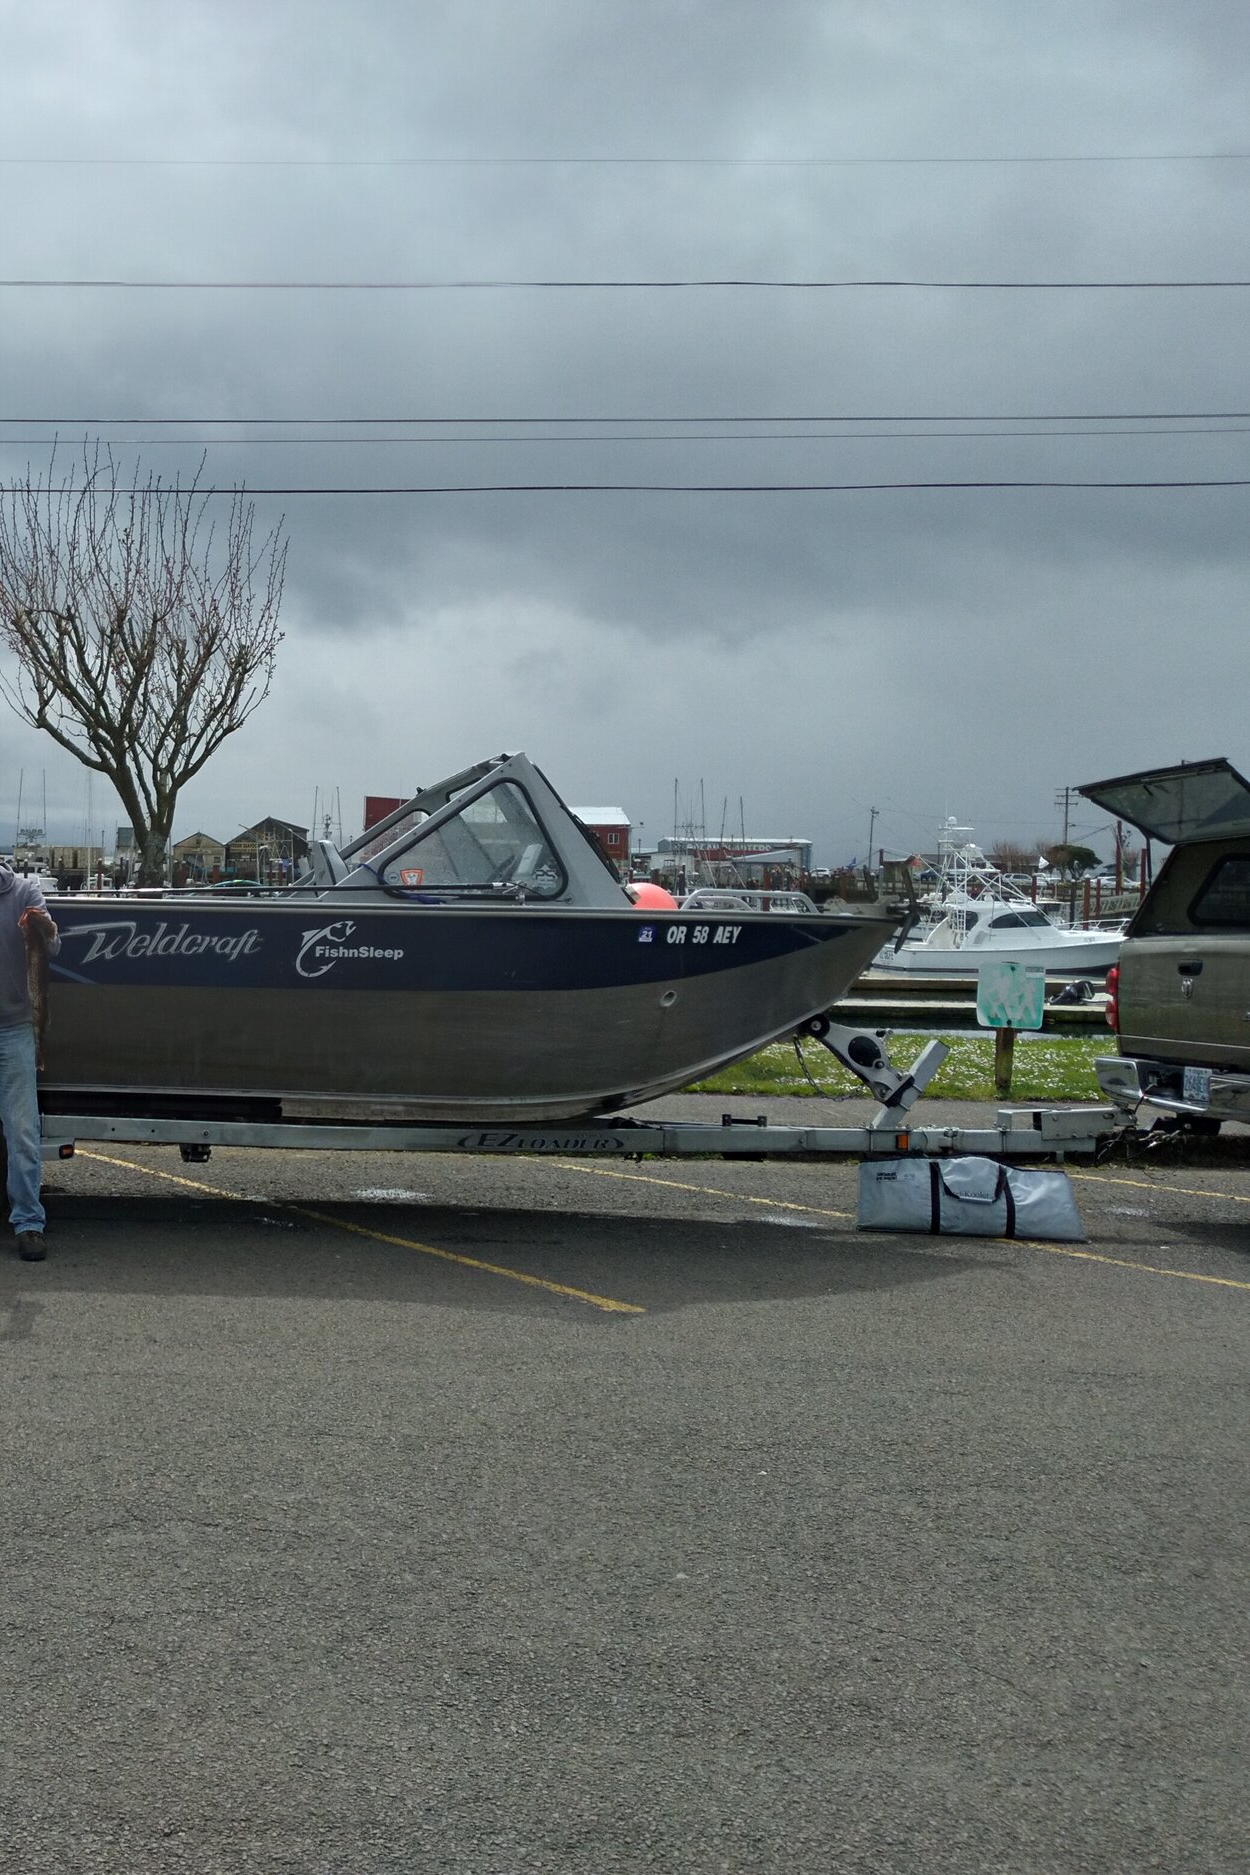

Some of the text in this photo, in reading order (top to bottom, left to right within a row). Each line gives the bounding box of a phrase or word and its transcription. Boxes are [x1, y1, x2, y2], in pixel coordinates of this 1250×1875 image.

[59, 921, 264, 965] Weldcraft
[666, 926, 742, 944] OR 58 AEY
[315, 945, 404, 960] FishnSleep
